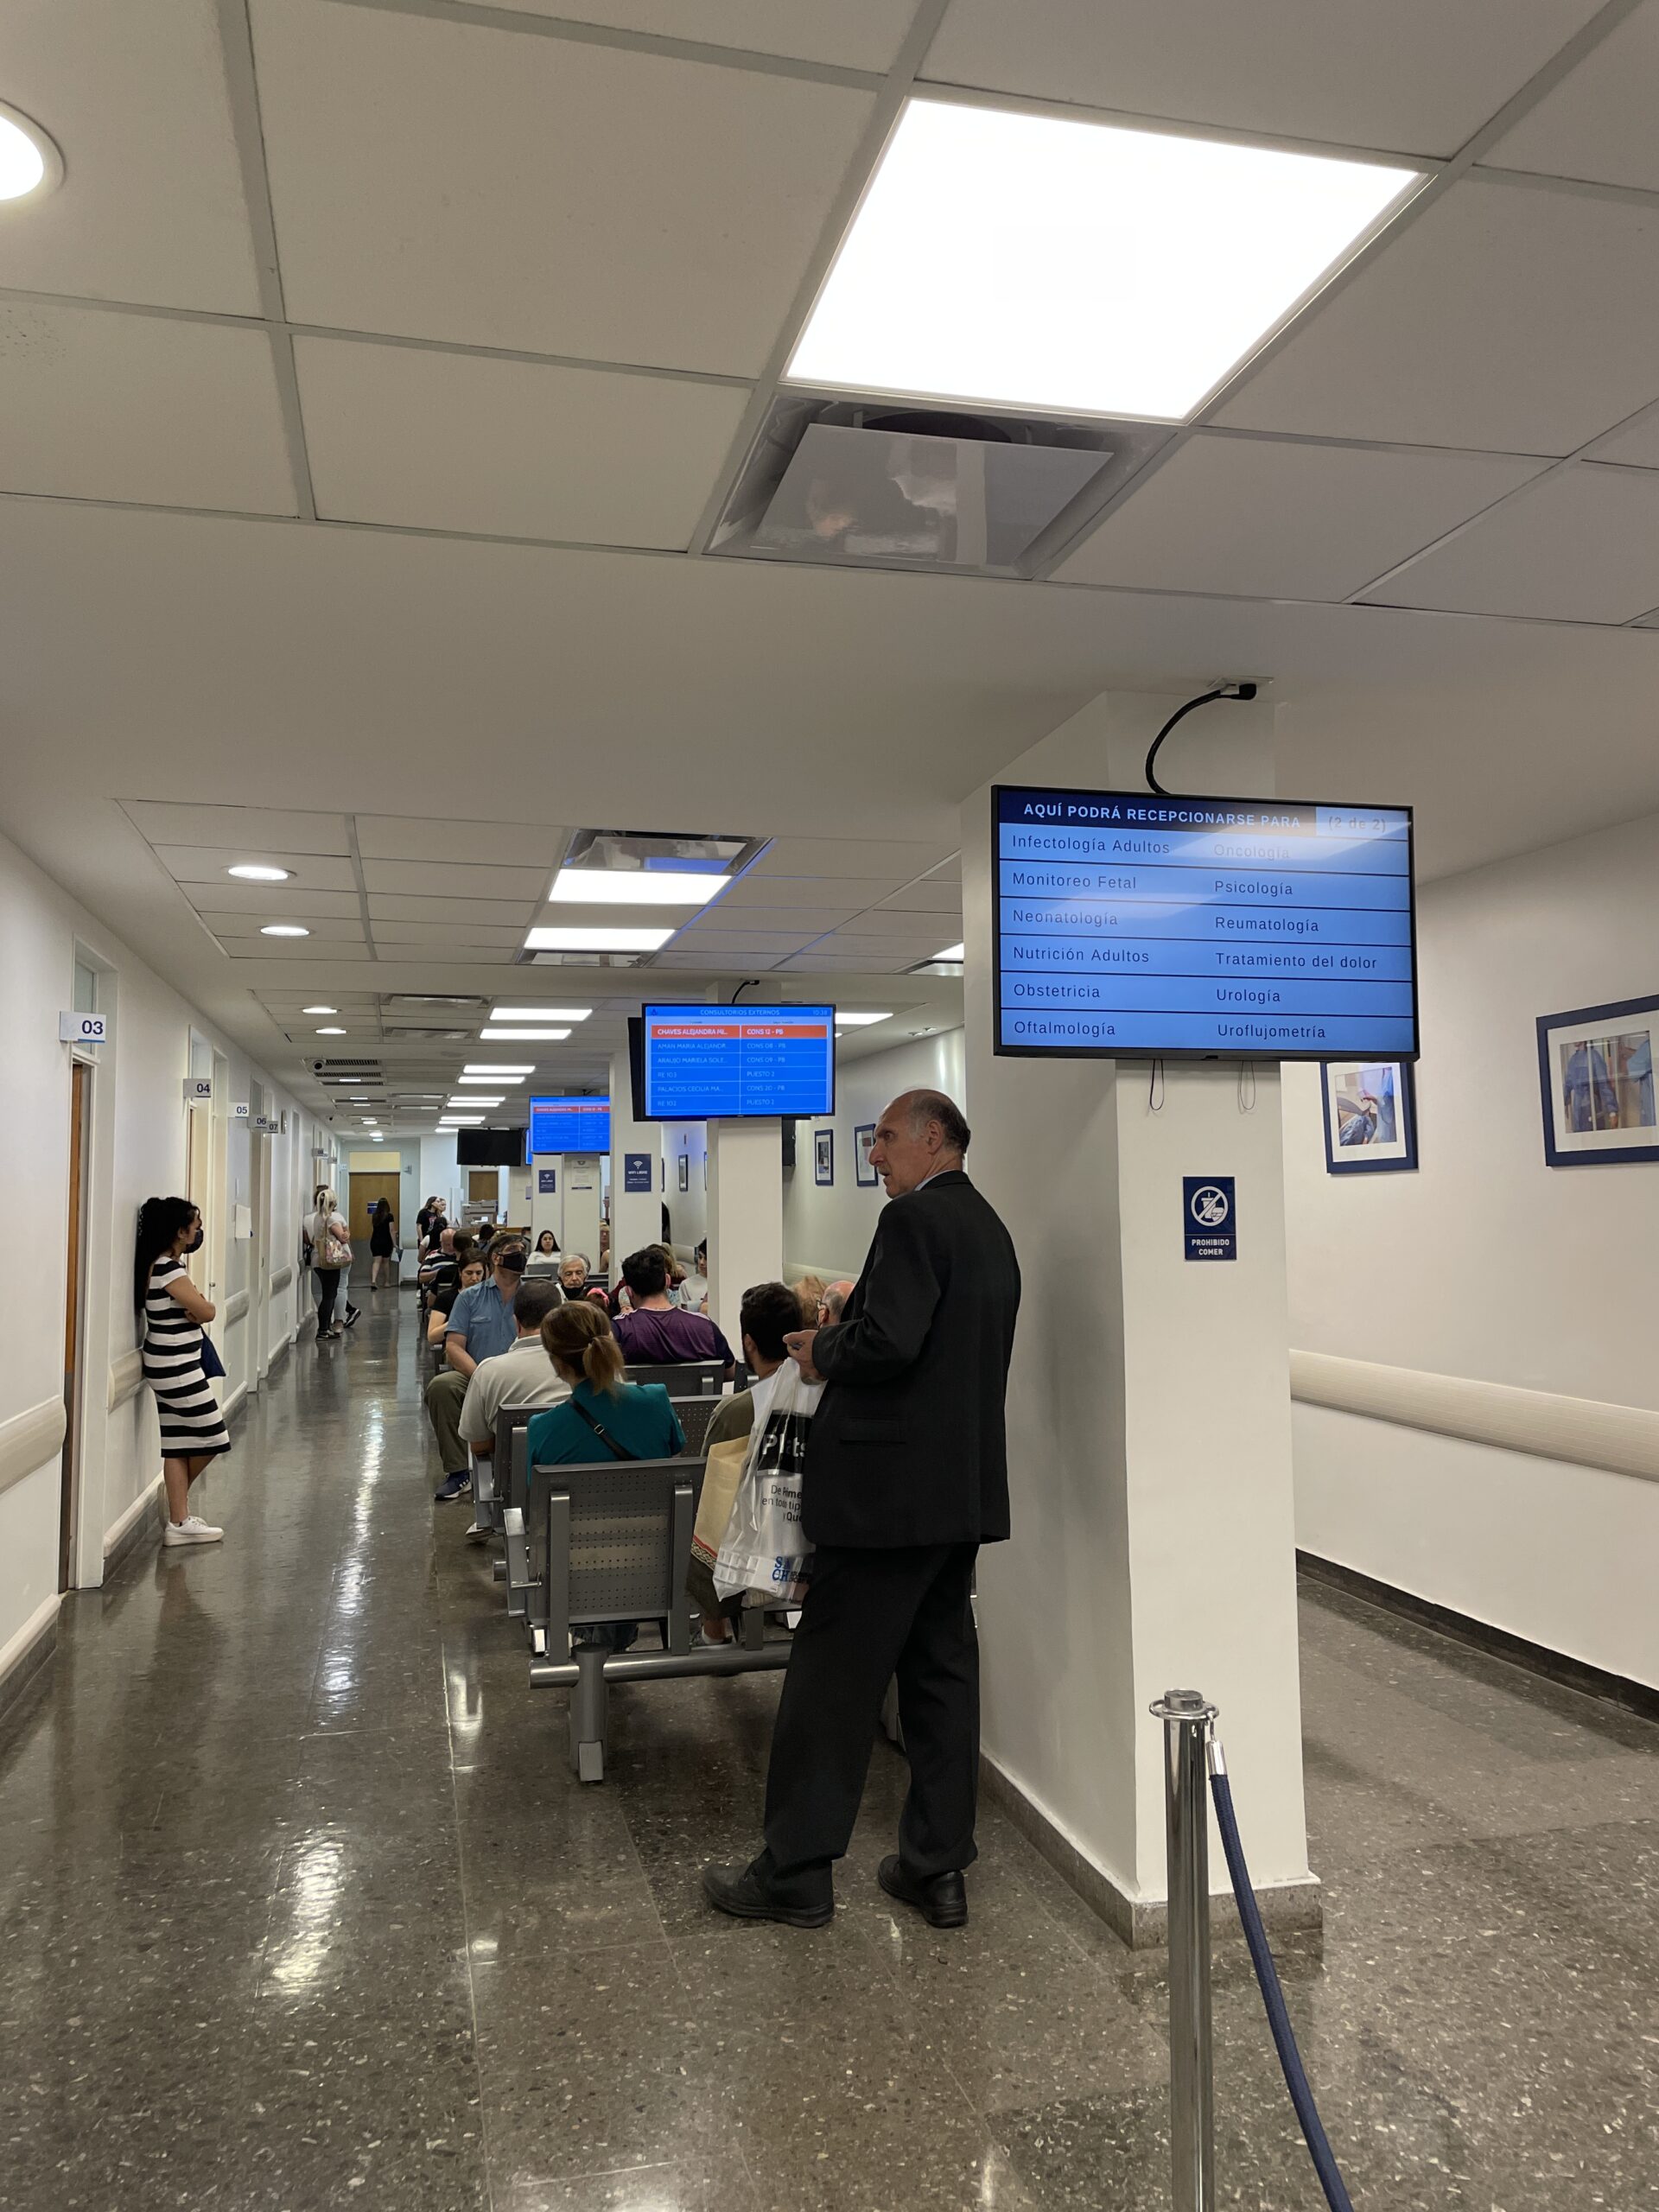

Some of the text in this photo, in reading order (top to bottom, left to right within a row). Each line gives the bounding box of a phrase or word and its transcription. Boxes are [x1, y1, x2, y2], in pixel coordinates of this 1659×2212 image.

[1024, 802, 1302, 829] AQUÍ PODRÁ RECEPCIONARSE PARA
[1348, 817, 1367, 830] de
[1013, 835, 1170, 855] Infectología Adultos
[1013, 872, 1137, 889] Monitoreo Fetal
[1215, 880, 1294, 897] Psicología
[1013, 909, 1118, 927] Neonatología
[1215, 917, 1319, 934] Reumatología
[1014, 946, 1150, 963] Nutrición Adultos
[1216, 952, 1377, 969] Tratamiento del dolor
[1014, 983, 1100, 998] Obstetricia
[1217, 988, 1281, 1004] Urología
[82, 1020, 104, 1034] 03
[1014, 1020, 1116, 1038] Oftalmología
[1217, 1024, 1325, 1040] Uroflujometría
[196, 1084, 210, 1093] 04
[772, 1485, 781, 1495] De
